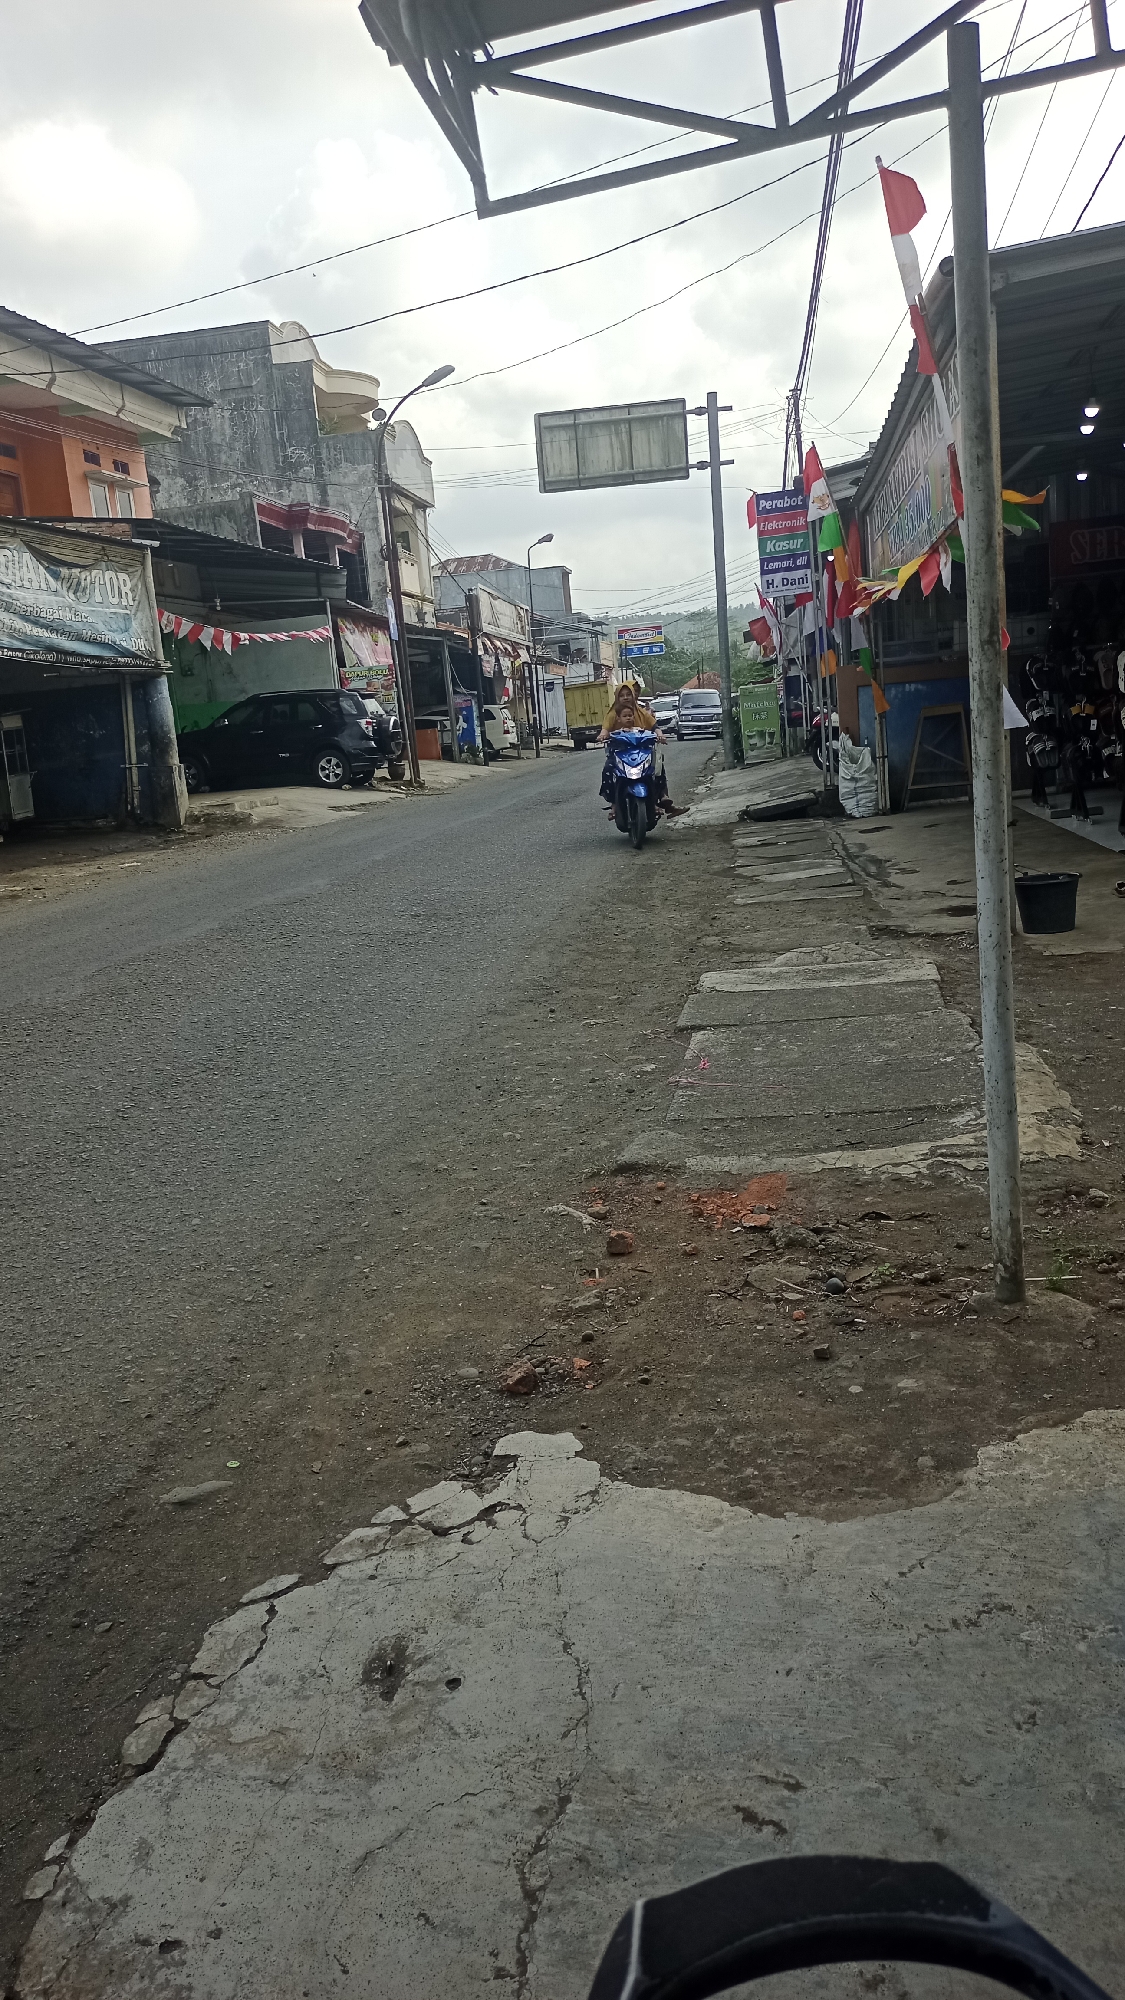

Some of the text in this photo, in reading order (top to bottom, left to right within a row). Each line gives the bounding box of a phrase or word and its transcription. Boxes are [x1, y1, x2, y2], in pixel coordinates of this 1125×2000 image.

[758, 495, 803, 511] Perabot
[759, 516, 806, 531] Elektronik
[765, 538, 804, 553] Kasur
[763, 556, 808, 570] Lemari, dll
[766, 579, 779, 590] H.
[781, 574, 809, 587] Dani
[9, 600, 63, 622] Berbagai
[81, 629, 112, 644] Mesin
[345, 670, 369, 678] DAPUR
[743, 700, 776, 709] Matcha
